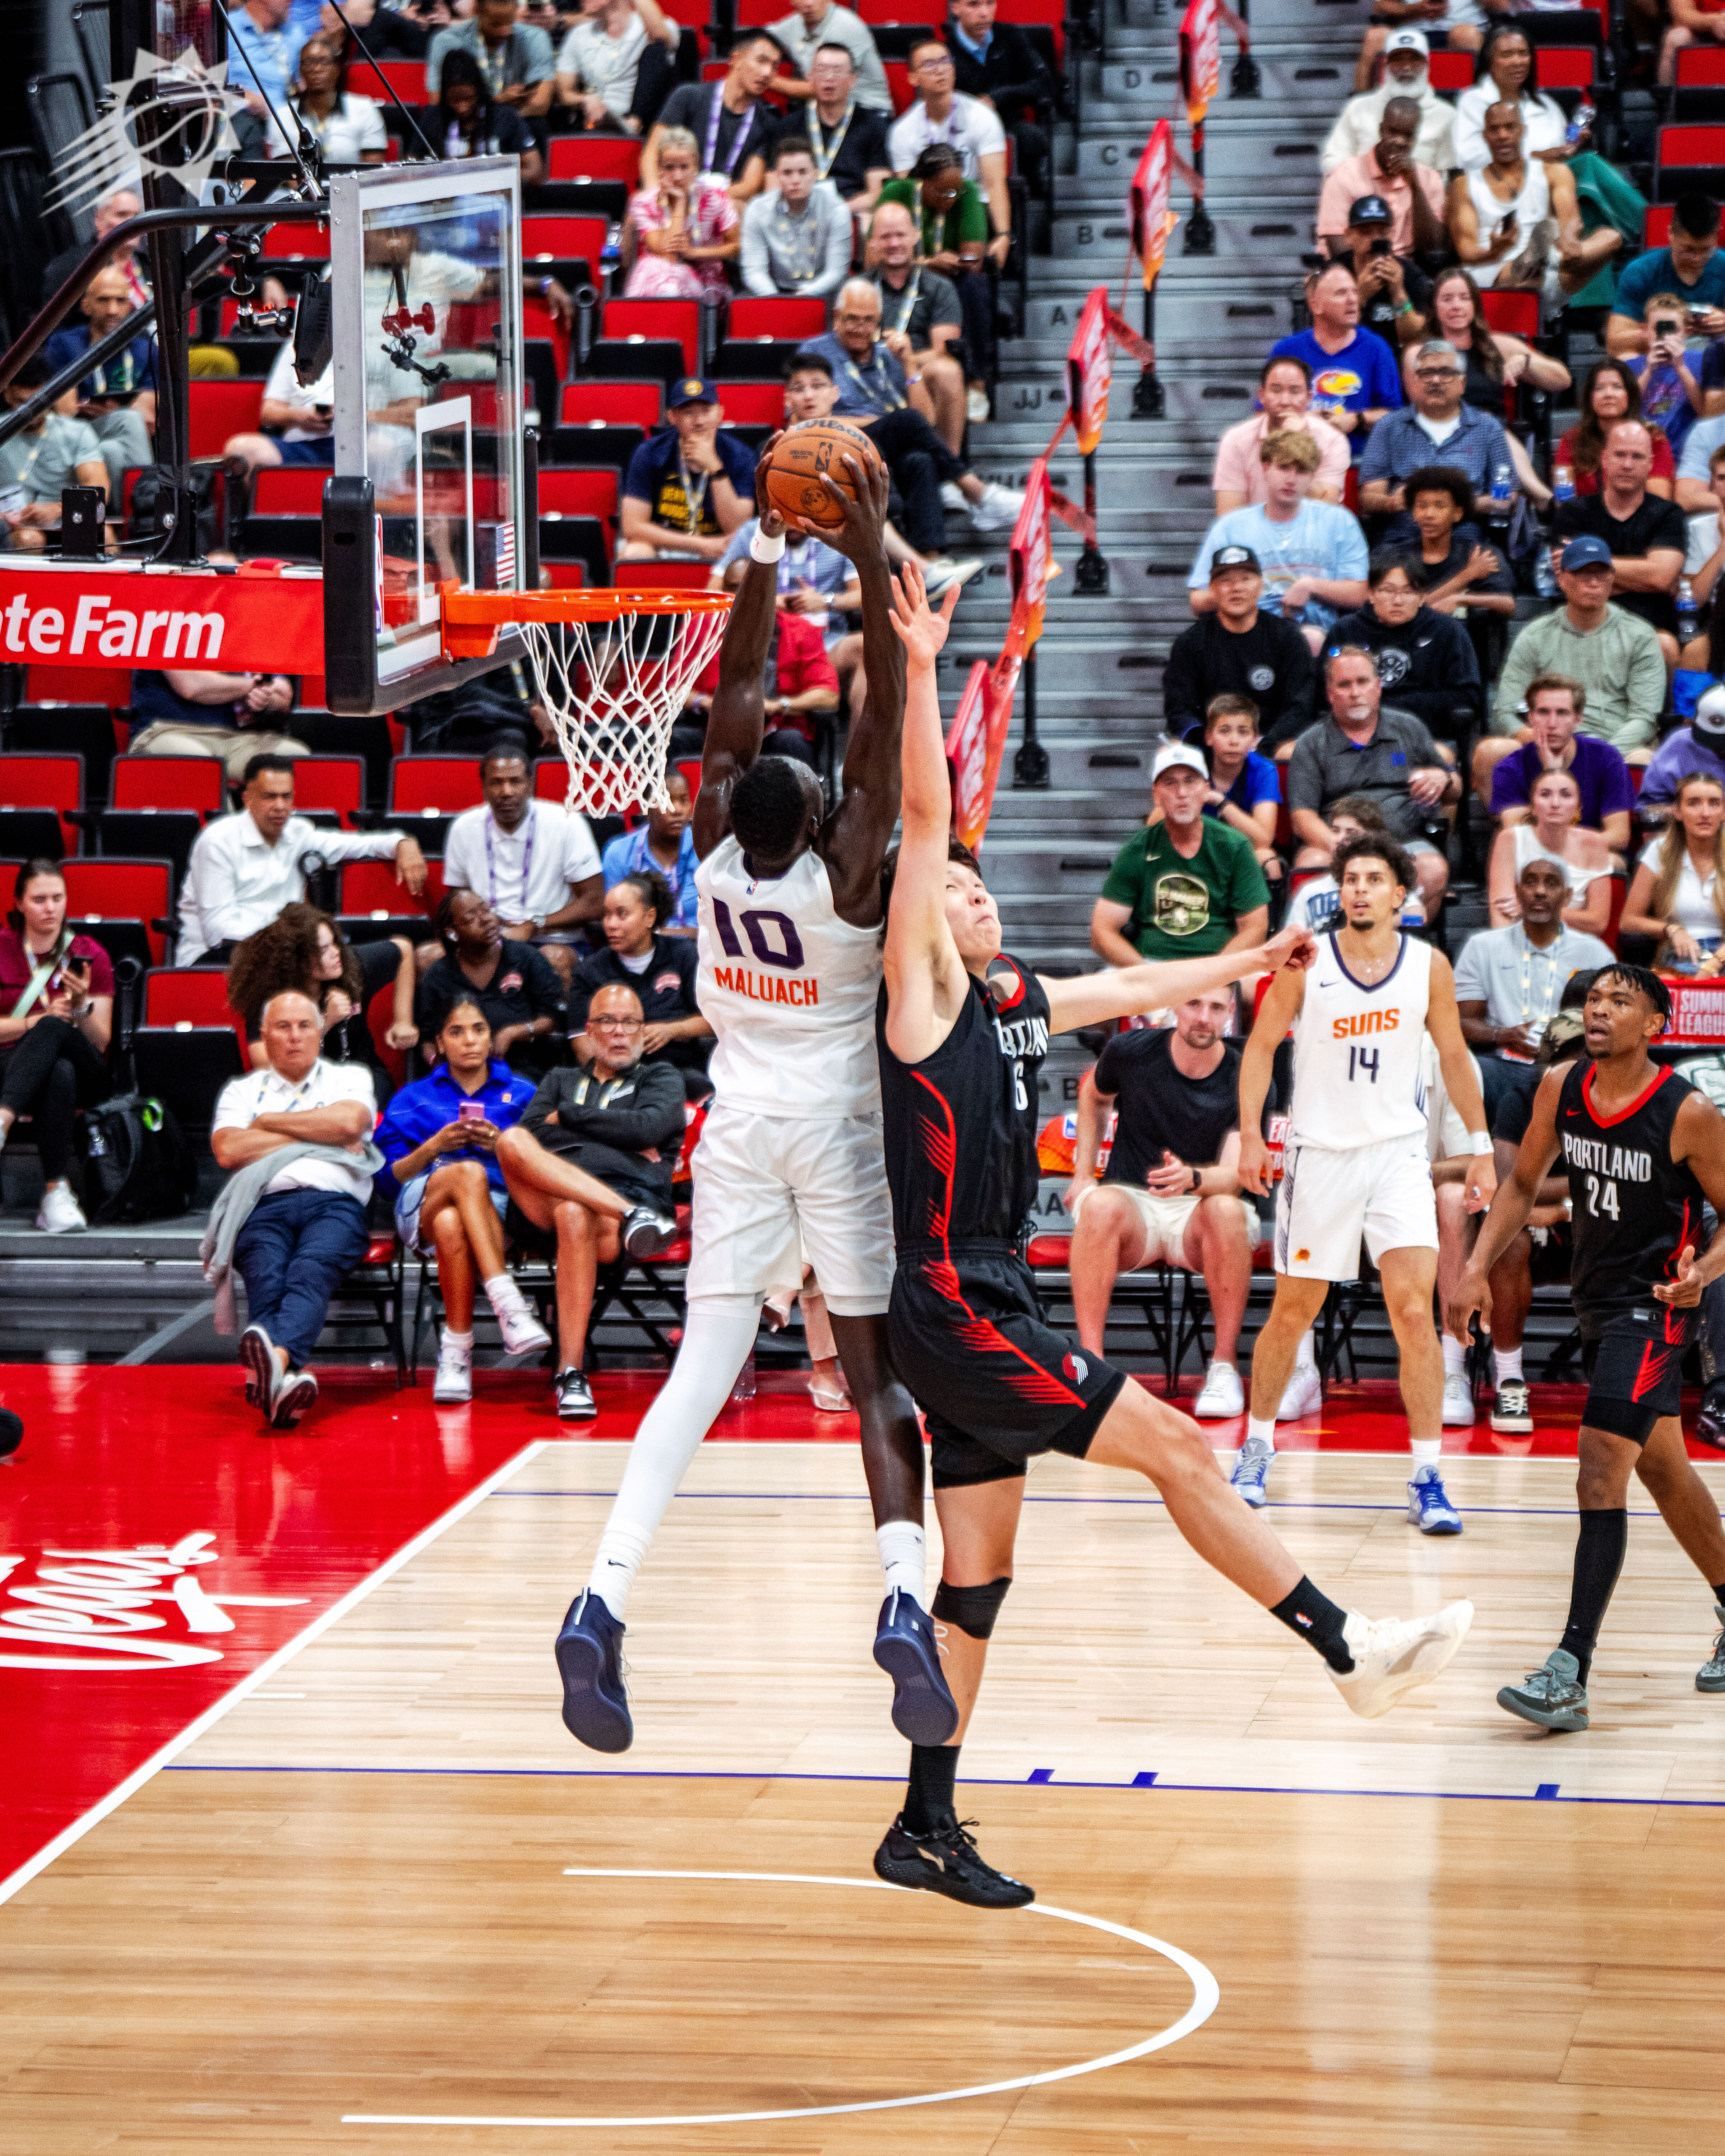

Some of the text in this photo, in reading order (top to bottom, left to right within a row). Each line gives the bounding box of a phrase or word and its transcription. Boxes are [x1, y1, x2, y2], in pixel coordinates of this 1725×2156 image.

[1125, 71, 1141, 89] D
[1101, 146, 1118, 165] C
[1078, 226, 1093, 245] B
[1051, 306, 1068, 325] A
[1013, 389, 1041, 410] JJ
[0, 593, 225, 659] te Farm
[712, 896, 805, 970] 10
[714, 967, 819, 1006] MALUACH
[1680, 990, 1725, 1014] SUMM
[1333, 1008, 1400, 1039] SUNS
[1678, 1013, 1725, 1036] LEAGU
[1349, 1045, 1380, 1084] 14
[1014, 1061, 1028, 1111] 6
[1563, 1133, 1652, 1183] PORTLAND
[1587, 1175, 1620, 1221] 24
